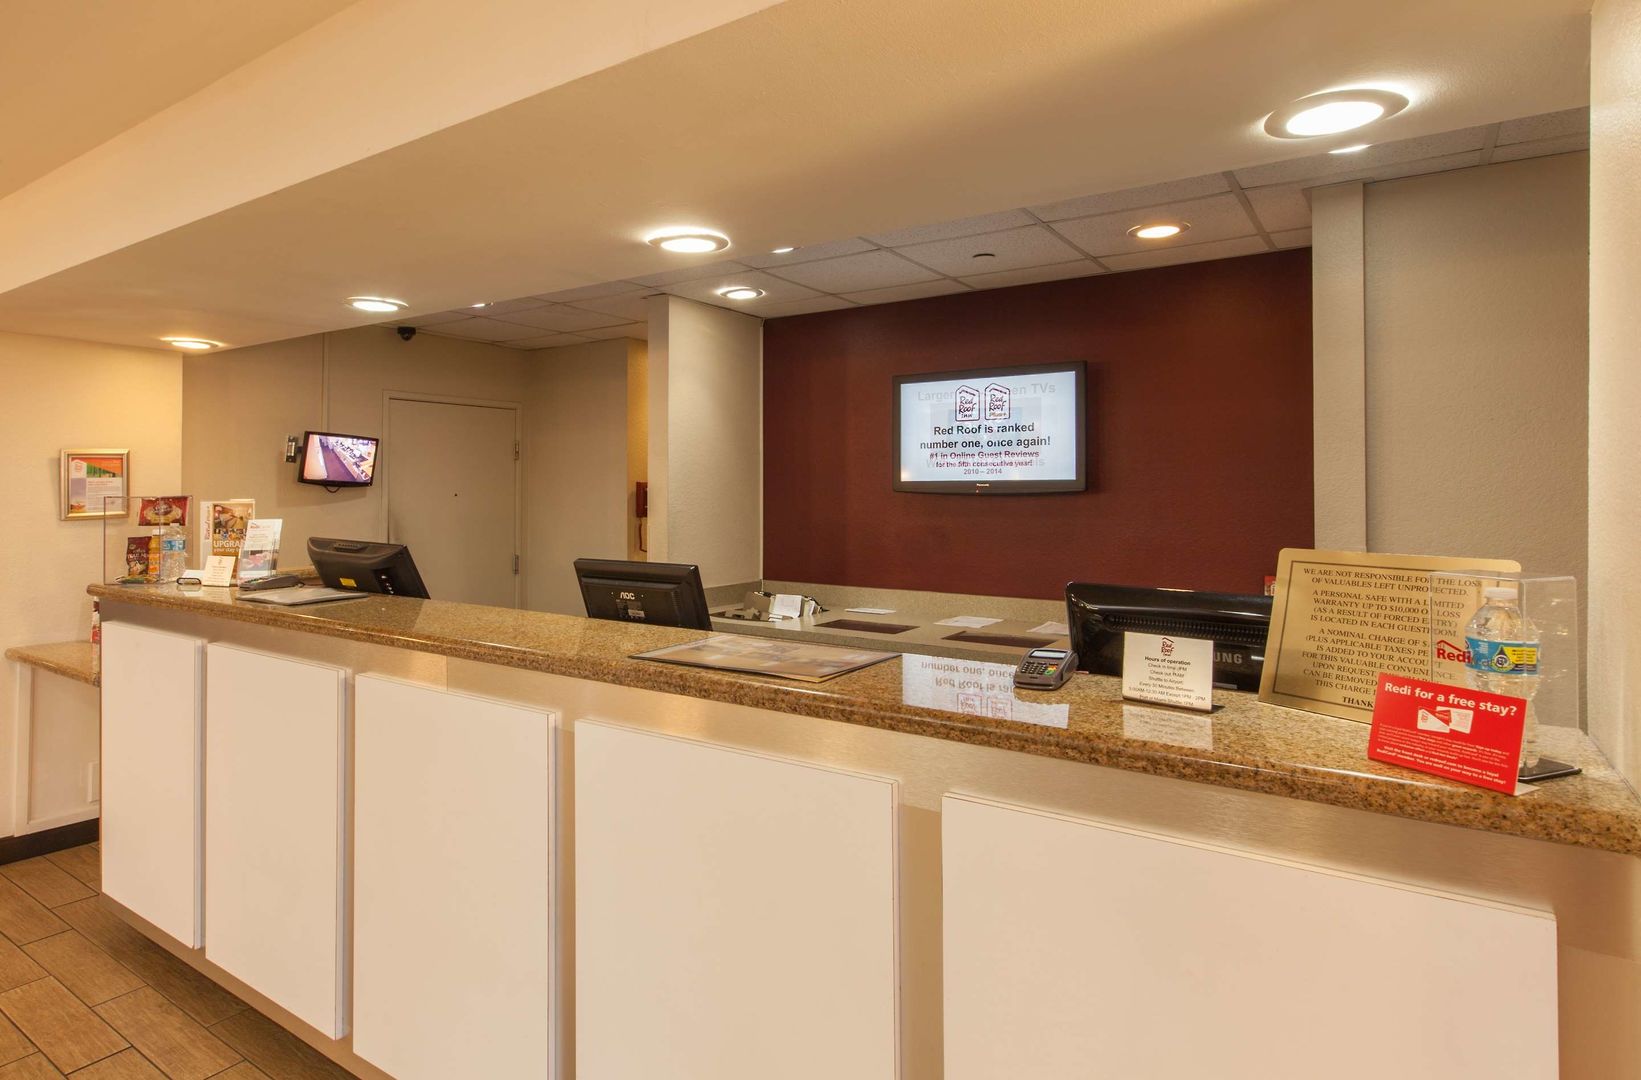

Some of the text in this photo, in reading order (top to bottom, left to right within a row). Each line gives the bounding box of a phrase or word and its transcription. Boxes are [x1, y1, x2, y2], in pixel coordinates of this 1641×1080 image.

[1031, 382, 1056, 393] TVs
[960, 396, 973, 404] Red
[990, 394, 1004, 402] Red
[959, 403, 976, 414] Roof
[989, 400, 1006, 411] Roof
[934, 422, 1034, 435] Red Roof is ranked
[920, 436, 1050, 449] number one, once again!
[1354, 572, 1412, 582] RESPONSIBLE
[1438, 578, 1456, 586] THE
[1324, 578, 1372, 588] VALUABLES
[1374, 582, 1396, 590] LEFT
[1398, 584, 1468, 596] UNPROECTED.
[1320, 590, 1362, 600] PERSONAL
[1366, 594, 1387, 602] SAFE
[1389, 596, 1412, 604] WITH
[1424, 599, 1464, 609] LMITED
[1314, 598, 1360, 608] WARRANTY
[1389, 604, 1419, 614] $10,000
[1437, 610, 1461, 618] LOSS
[1320, 616, 1358, 626] LOCATED
[1371, 622, 1394, 630] EACH
[1336, 608, 1369, 618] RESULT
[1384, 614, 1420, 623] FORCED
[1422, 618, 1458, 628] ETRY)
[1327, 629, 1366, 640] NOMINAL
[1369, 634, 1406, 644] CHARGE
[1329, 638, 1382, 651] APPLICABLE
[1384, 645, 1416, 654] TAXES)
[1325, 646, 1354, 656] ADDED
[1370, 652, 1394, 661] YOUR
[1397, 657, 1442, 668] ACCOUT
[1340, 657, 1385, 669] VALUABLE
[1312, 662, 1336, 670] UPON
[1336, 674, 1378, 686] REMOVED
[1315, 679, 1372, 695] THIS CHARGE
[1342, 696, 1374, 708] THANK
[1384, 682, 1517, 716] Redi for a free stay?
